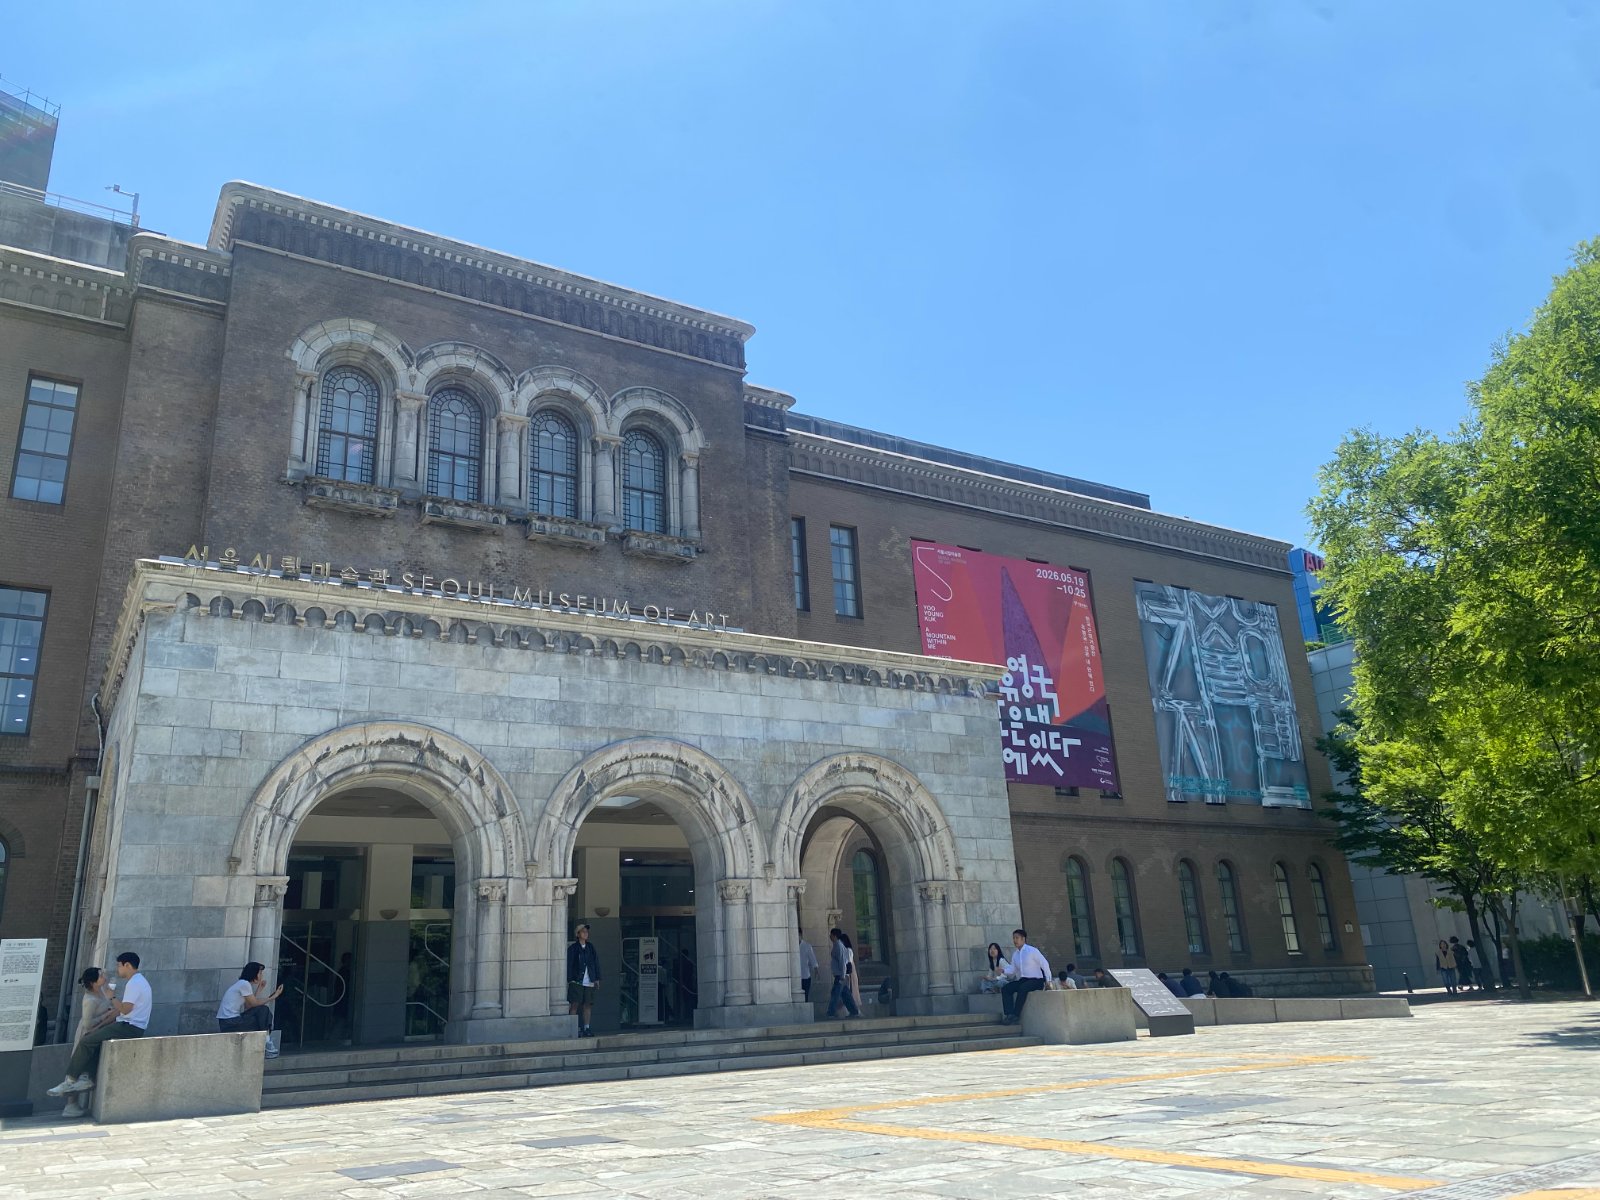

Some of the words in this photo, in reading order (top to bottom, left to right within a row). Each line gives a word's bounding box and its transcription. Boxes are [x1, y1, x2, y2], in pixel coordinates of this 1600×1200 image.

[183, 544, 391, 588] 서울시립미술관
[1036, 567, 1084, 587] 2026.05.19
[402, 572, 498, 602] SEOUL
[512, 586, 631, 620] MUSEUM
[643, 605, 675, 626] OF
[687, 609, 730, 631] ART
[999, 653, 1060, 718] 유영국
[1025, 703, 1051, 725] 내
